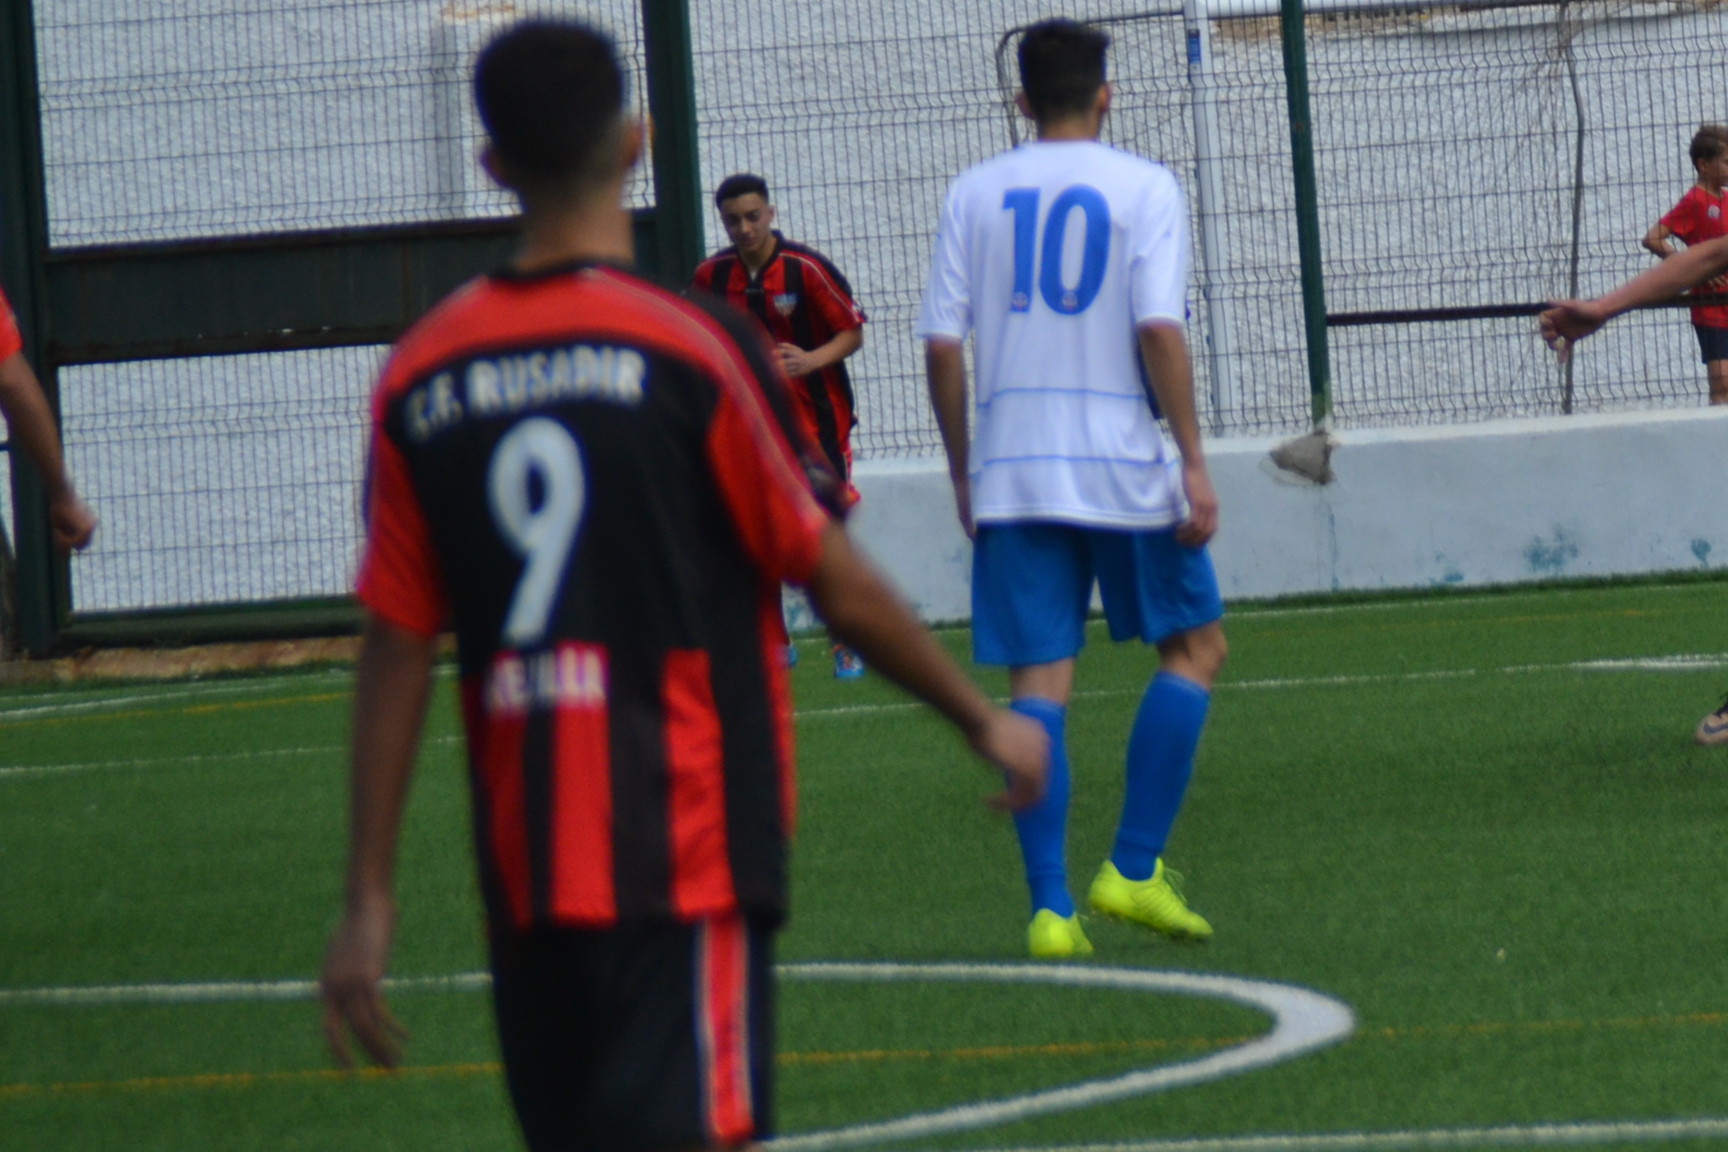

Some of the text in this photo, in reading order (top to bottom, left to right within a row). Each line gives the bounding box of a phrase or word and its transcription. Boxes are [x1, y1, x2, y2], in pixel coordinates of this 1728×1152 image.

[1002, 184, 1111, 315] 10
[466, 345, 648, 418] RUSADIR
[487, 415, 586, 644] 9
